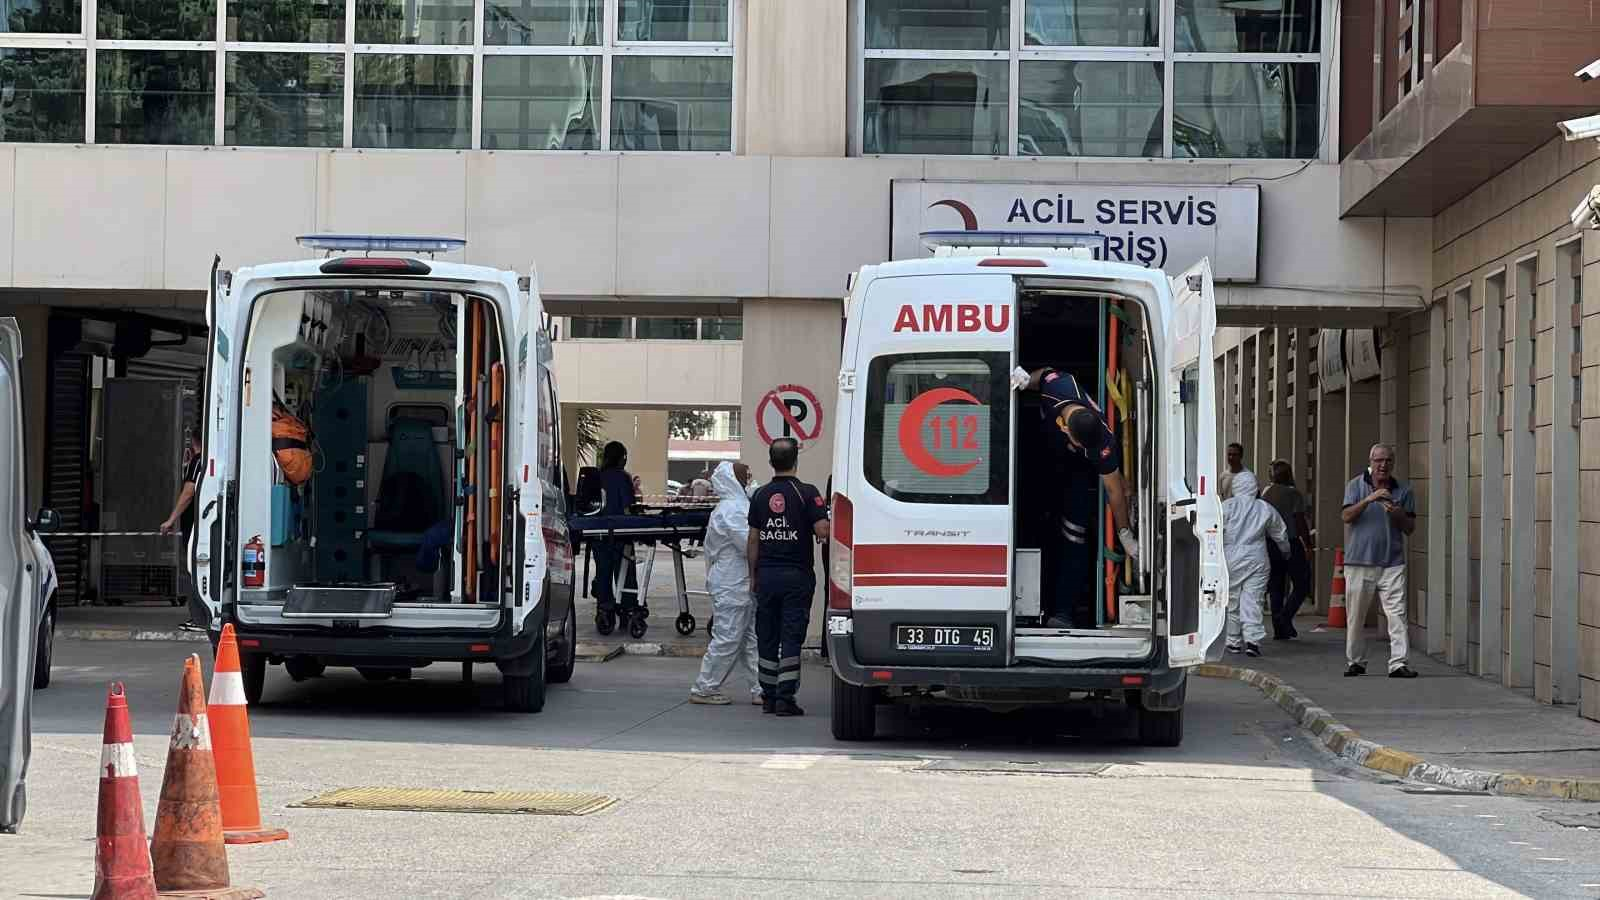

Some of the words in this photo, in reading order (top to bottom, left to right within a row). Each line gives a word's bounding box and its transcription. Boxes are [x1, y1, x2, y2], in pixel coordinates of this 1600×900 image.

[1007, 193, 1085, 224] ACİL
[1095, 196, 1217, 227] SERVİS
[1093, 230, 1168, 269] İRİŞ)
[893, 304, 1010, 333] AMBU
[929, 415, 979, 449] 112
[766, 515, 790, 528] ACİ
[903, 529, 972, 537] TRANSIT
[907, 628, 924, 644] 33
[934, 629, 960, 645] DTG
[973, 629, 990, 646] 45
